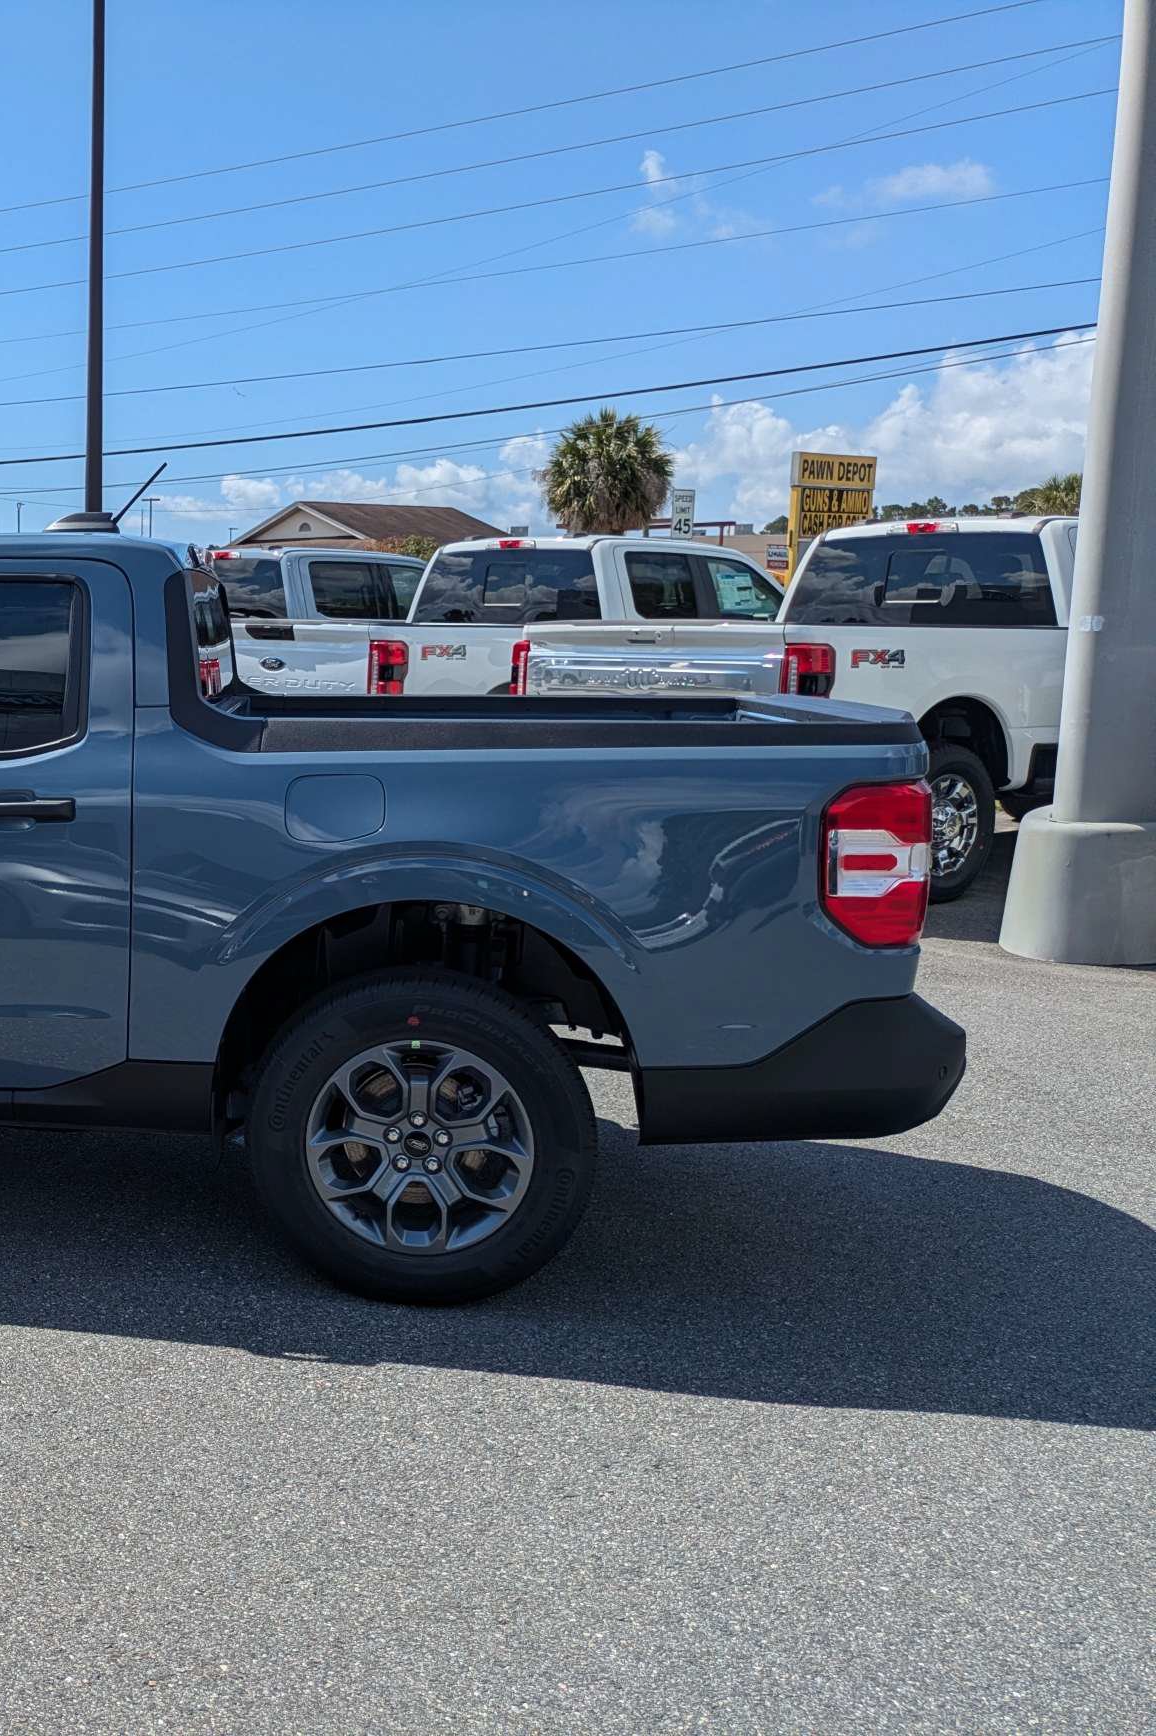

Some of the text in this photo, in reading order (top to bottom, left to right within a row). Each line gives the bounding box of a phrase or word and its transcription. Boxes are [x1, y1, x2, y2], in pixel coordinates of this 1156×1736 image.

[802, 460, 873, 482] PAWN DEPOT
[803, 488, 870, 514] GUNS & AMMO
[674, 518, 691, 534] 45
[801, 513, 824, 535] CASH
[421, 645, 466, 660] FX4
[851, 649, 905, 668] FX4
[285, 678, 356, 692] DUTY
